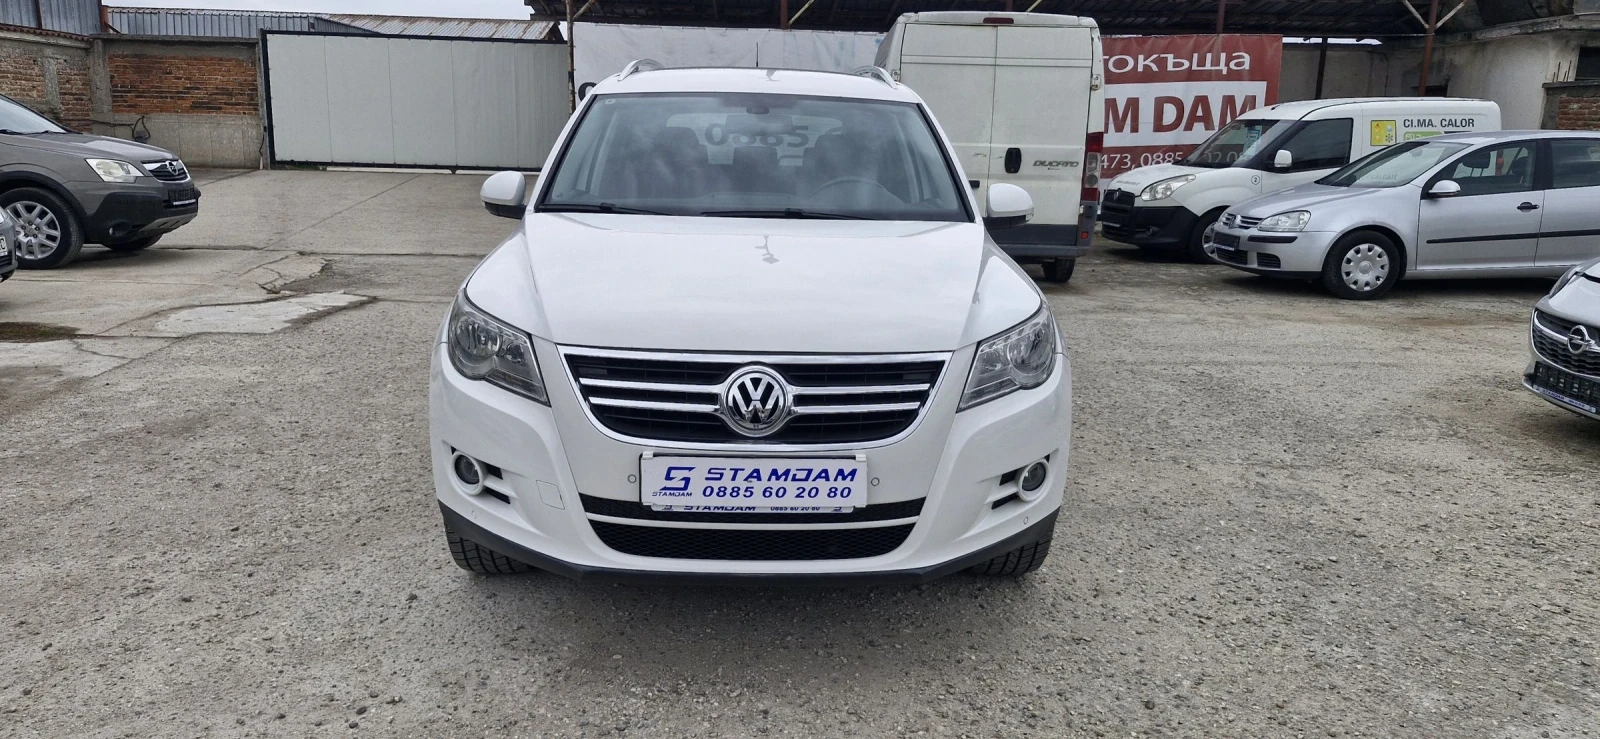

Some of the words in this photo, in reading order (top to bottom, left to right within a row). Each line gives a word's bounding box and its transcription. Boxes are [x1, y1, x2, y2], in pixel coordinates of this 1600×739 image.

[1152, 95, 1257, 132] DAM
[1403, 118, 1437, 128] CI.MA.
[1440, 118, 1475, 128] CALOR
[1032, 160, 1080, 168] DUCATO
[704, 467, 858, 482] STAMDAM
[702, 485, 755, 498] 0885
[762, 486, 788, 499] 60
[794, 486, 820, 499] 20
[826, 486, 852, 499] 80
